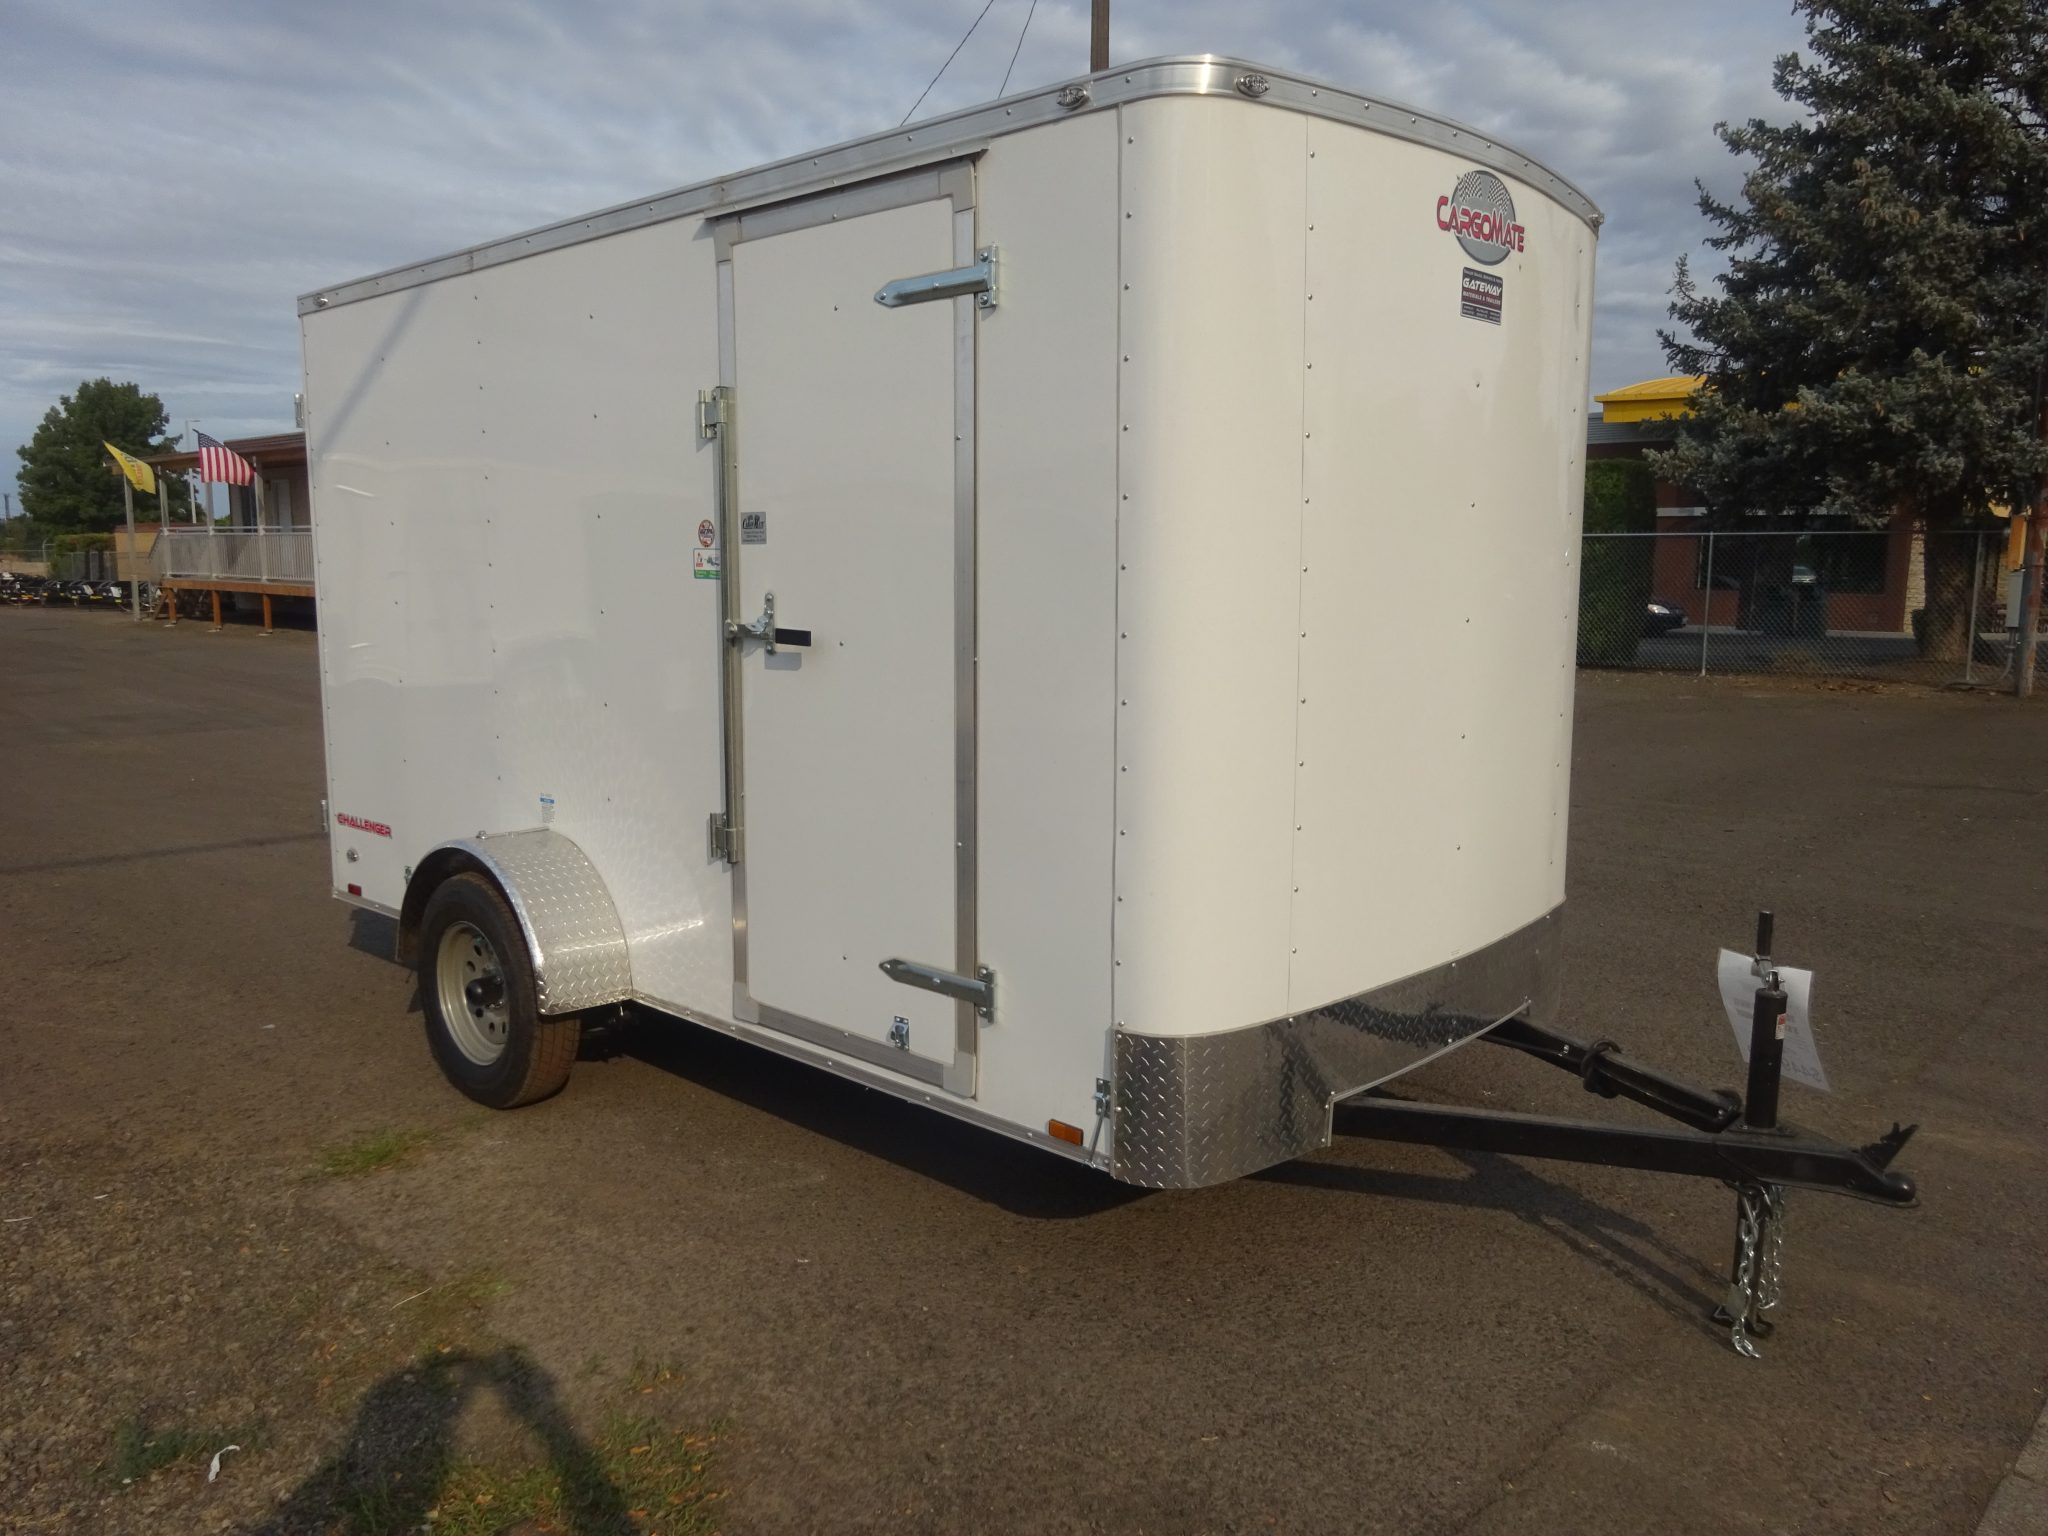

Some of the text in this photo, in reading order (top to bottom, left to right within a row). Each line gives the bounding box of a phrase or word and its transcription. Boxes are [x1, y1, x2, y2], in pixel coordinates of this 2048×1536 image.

[1437, 195, 1525, 253] CARGOMATE
[1463, 278, 1502, 296] GATEWAY
[337, 813, 392, 839] CHALLENGER
